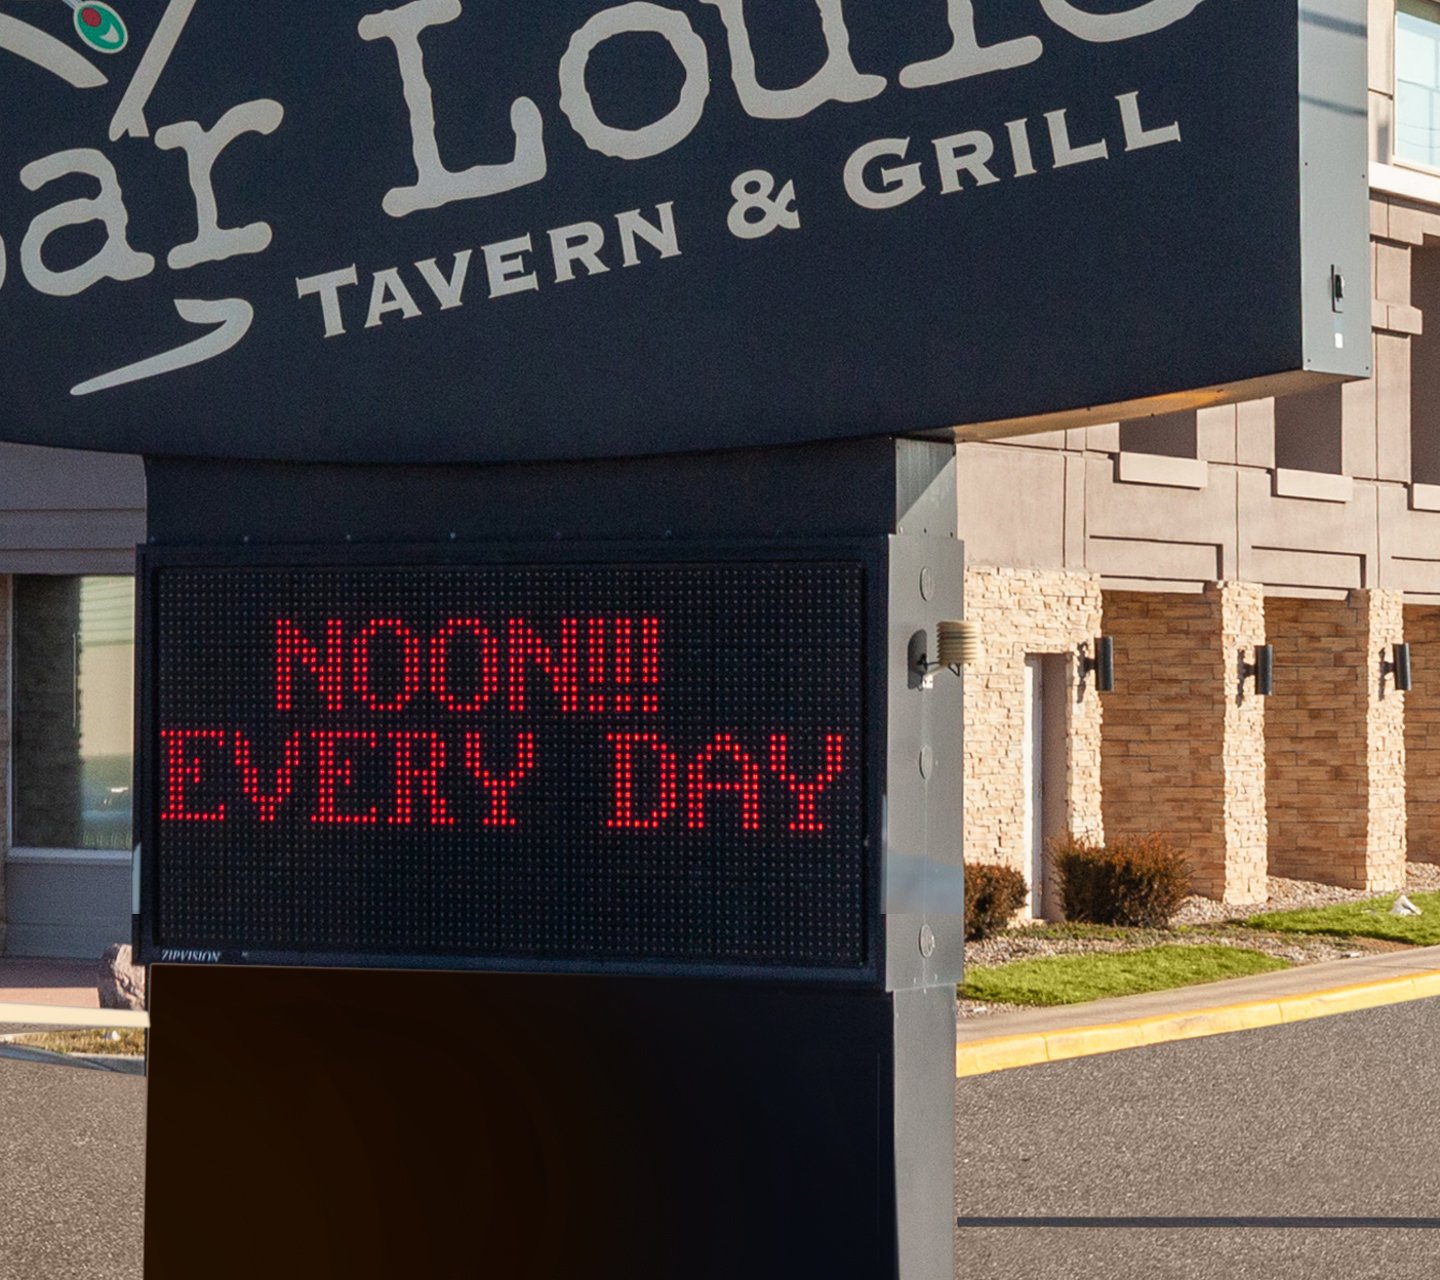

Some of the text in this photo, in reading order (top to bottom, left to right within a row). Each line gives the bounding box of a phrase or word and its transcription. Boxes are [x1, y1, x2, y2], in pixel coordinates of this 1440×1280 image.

[726, 168, 801, 239] &
[275, 616, 660, 715] NOON!!!
[159, 728, 845, 833] EVERY DAY
